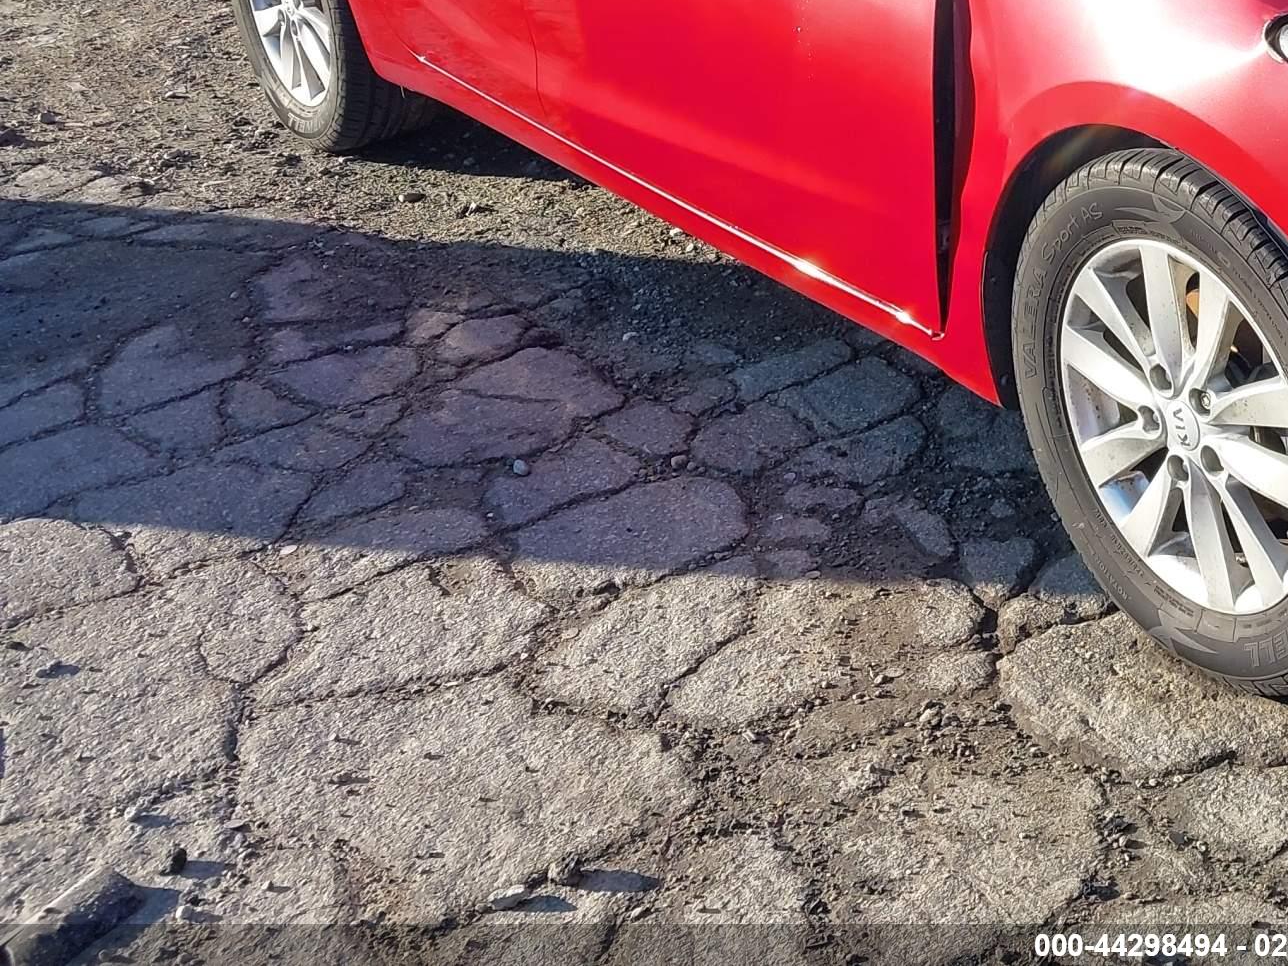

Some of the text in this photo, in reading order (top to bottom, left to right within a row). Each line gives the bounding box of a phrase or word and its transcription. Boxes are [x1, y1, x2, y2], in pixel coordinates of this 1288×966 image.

[1022, 201, 1103, 379] VALERA Sport AS
[1172, 407, 1191, 447] KIA
